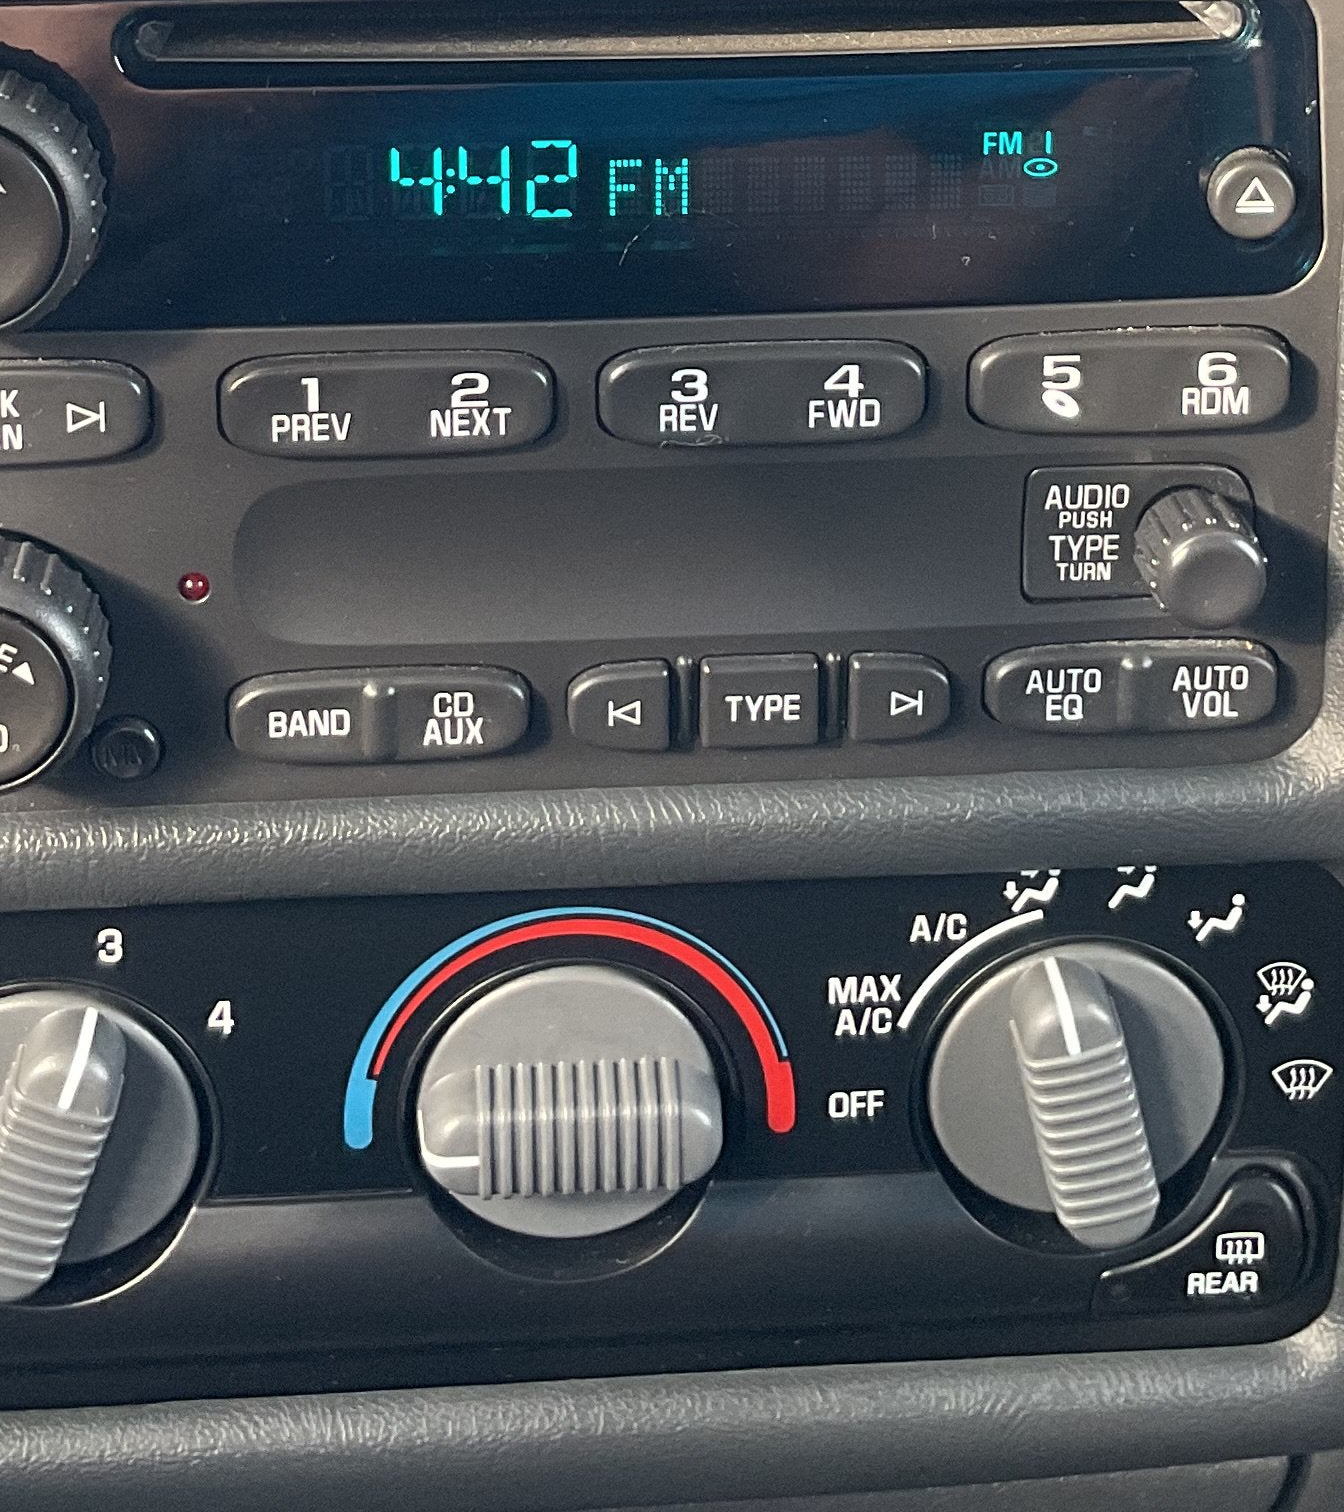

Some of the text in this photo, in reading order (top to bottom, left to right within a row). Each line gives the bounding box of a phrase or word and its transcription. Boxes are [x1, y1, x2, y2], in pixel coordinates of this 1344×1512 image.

[984, 132, 1022, 155] FM
[391, 140, 688, 218] 4:42 FM
[824, 365, 864, 397] 4
[1042, 355, 1080, 389] 5
[1198, 352, 1237, 386] 6
[301, 378, 319, 411] 1
[451, 373, 489, 406] 2
[672, 369, 708, 402] 3
[809, 399, 880, 428] FWD
[1182, 387, 1249, 415] RDM
[272, 413, 351, 442] PREV
[431, 408, 511, 437] NEXT
[660, 404, 718, 432] REV
[1045, 484, 1129, 510] AUDIO
[1059, 511, 1112, 528] PUSH
[1049, 535, 1119, 560] TYPE
[1056, 563, 1111, 580] TURN
[1026, 669, 1101, 694] AUTO
[1173, 666, 1248, 690] AUTO
[430, 692, 473, 718] CD
[725, 695, 800, 722] TYPE
[1046, 695, 1083, 721] EQ
[1182, 691, 1238, 718] VOL
[269, 709, 350, 738] BAND
[423, 718, 483, 746] AUX
[910, 913, 967, 942] A/C
[98, 929, 122, 963] 3
[829, 974, 901, 1005] MAX
[208, 1001, 234, 1035] 4
[835, 1007, 892, 1036] A/C
[829, 1090, 884, 1118] OFF
[1188, 1271, 1258, 1294] REAR
